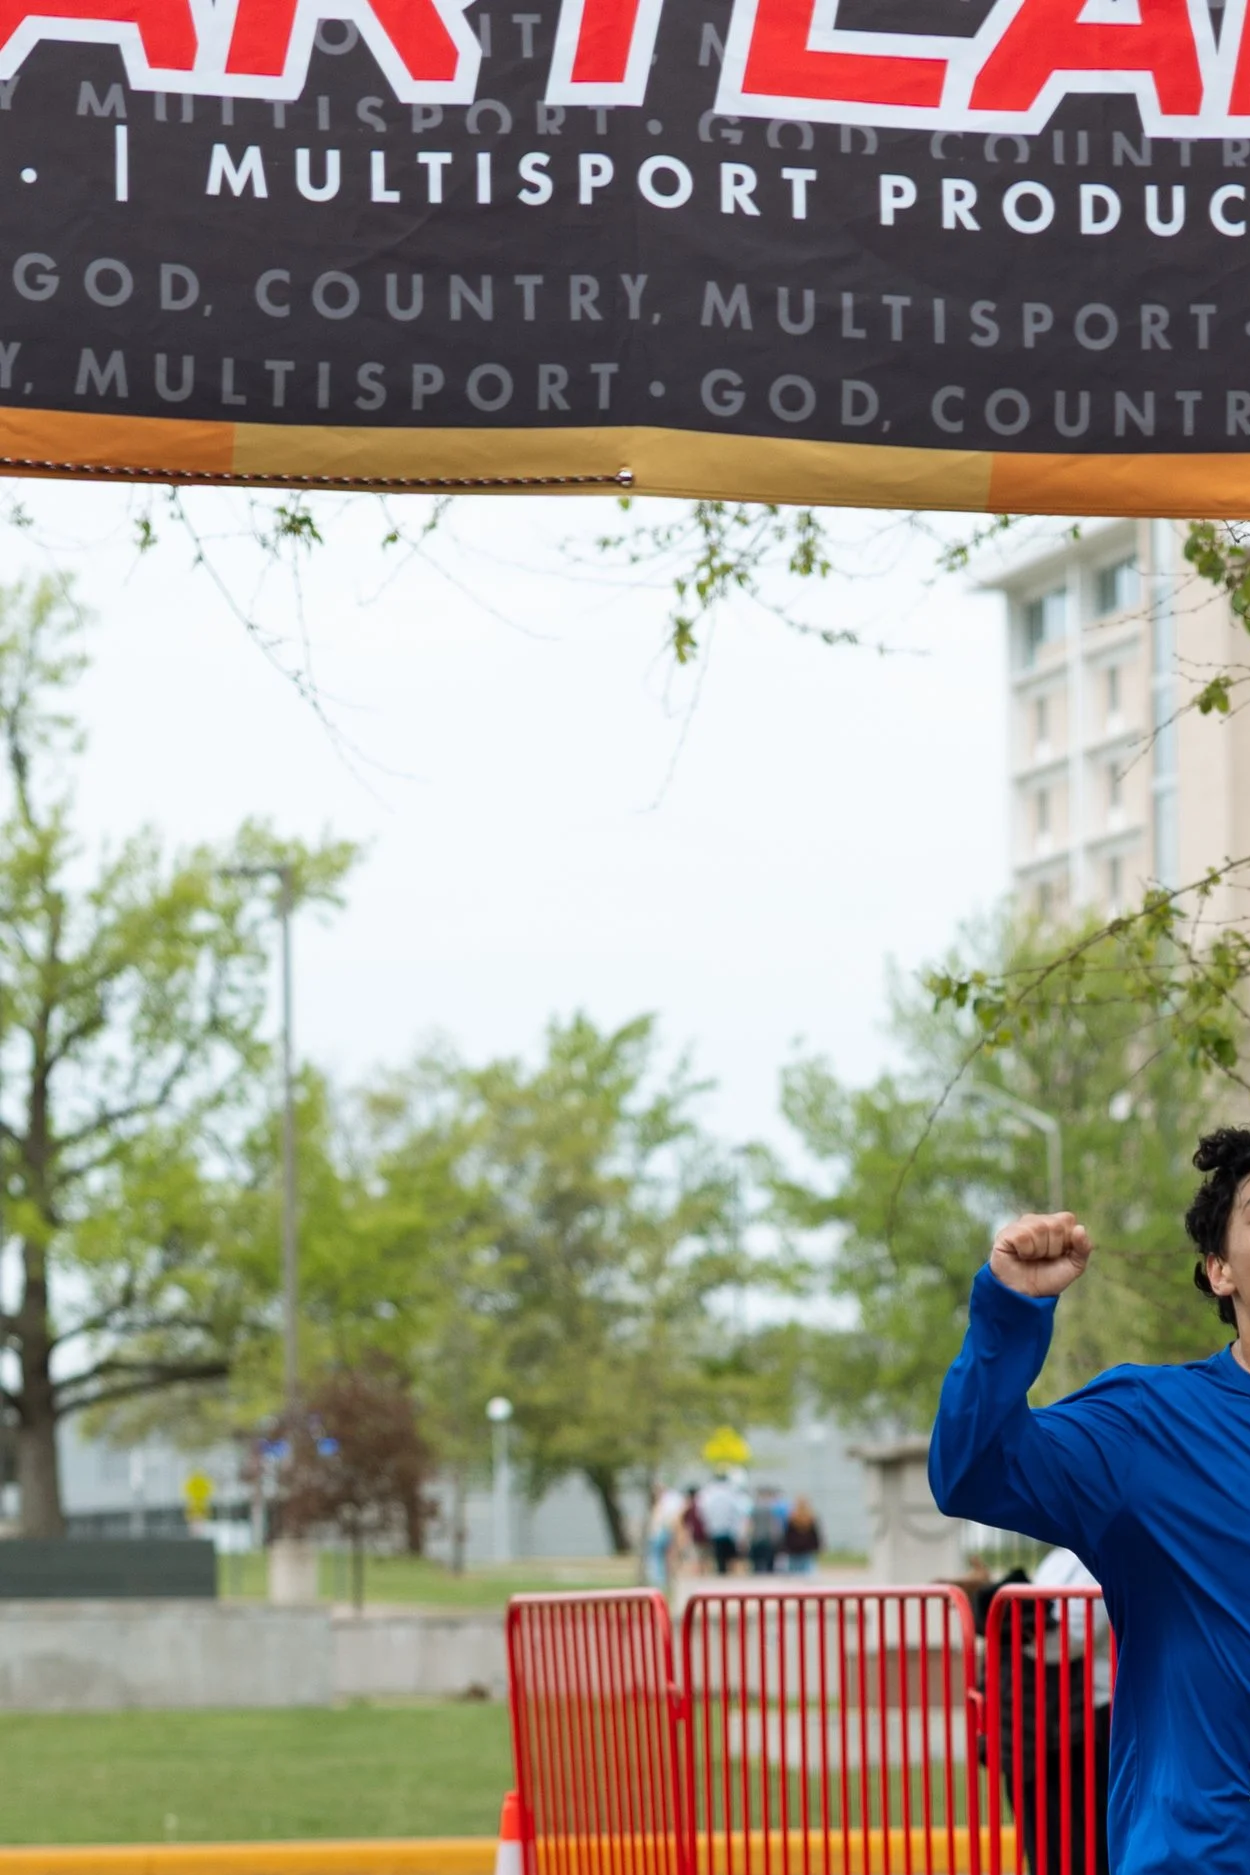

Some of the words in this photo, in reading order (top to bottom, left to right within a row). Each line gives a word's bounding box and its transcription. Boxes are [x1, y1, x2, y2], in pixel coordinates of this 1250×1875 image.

[206, 143, 817, 220] MULTISPORT
[13, 252, 212, 317] GOD,
[255, 268, 662, 325] COUNTRY,
[700, 281, 1217, 350] MULTISPORT
[75, 347, 619, 412] MULTISPORT
[700, 368, 891, 432] GOD,
